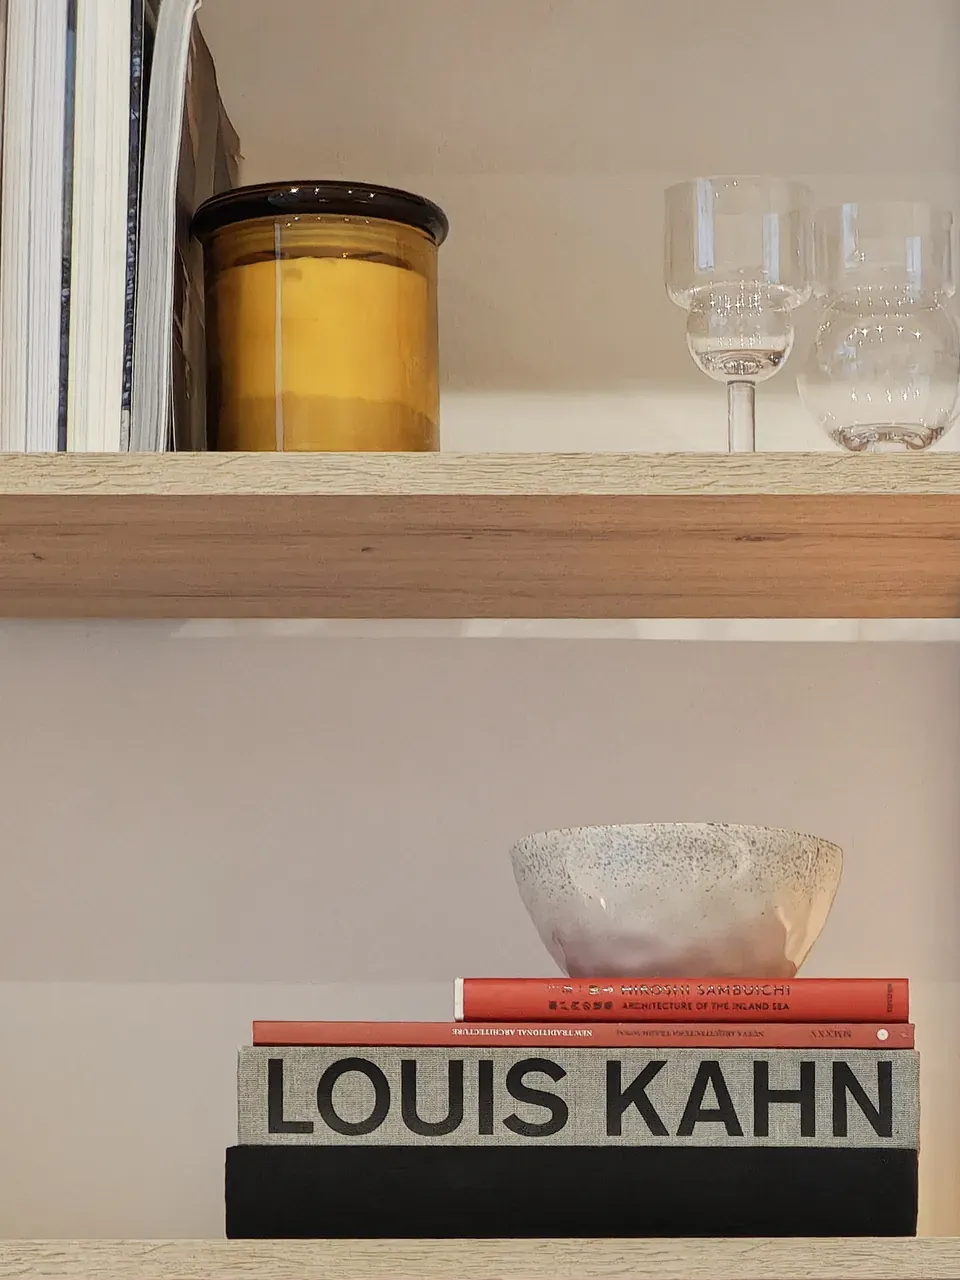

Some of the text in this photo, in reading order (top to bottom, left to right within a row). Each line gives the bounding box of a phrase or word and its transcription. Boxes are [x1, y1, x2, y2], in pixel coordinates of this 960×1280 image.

[697, 984, 791, 996] SAMBUICHI
[622, 1001, 692, 1011] ARCHITECTURE
[696, 1001, 709, 1011] OF
[711, 1001, 729, 1011] THE
[732, 1001, 769, 1011] INLAND
[772, 1001, 790, 1011] SEA
[452, 1028, 593, 1037] NEW TRADITIONAL ARCHITECTURE
[267, 1057, 892, 1138] LOUIS KAHN
